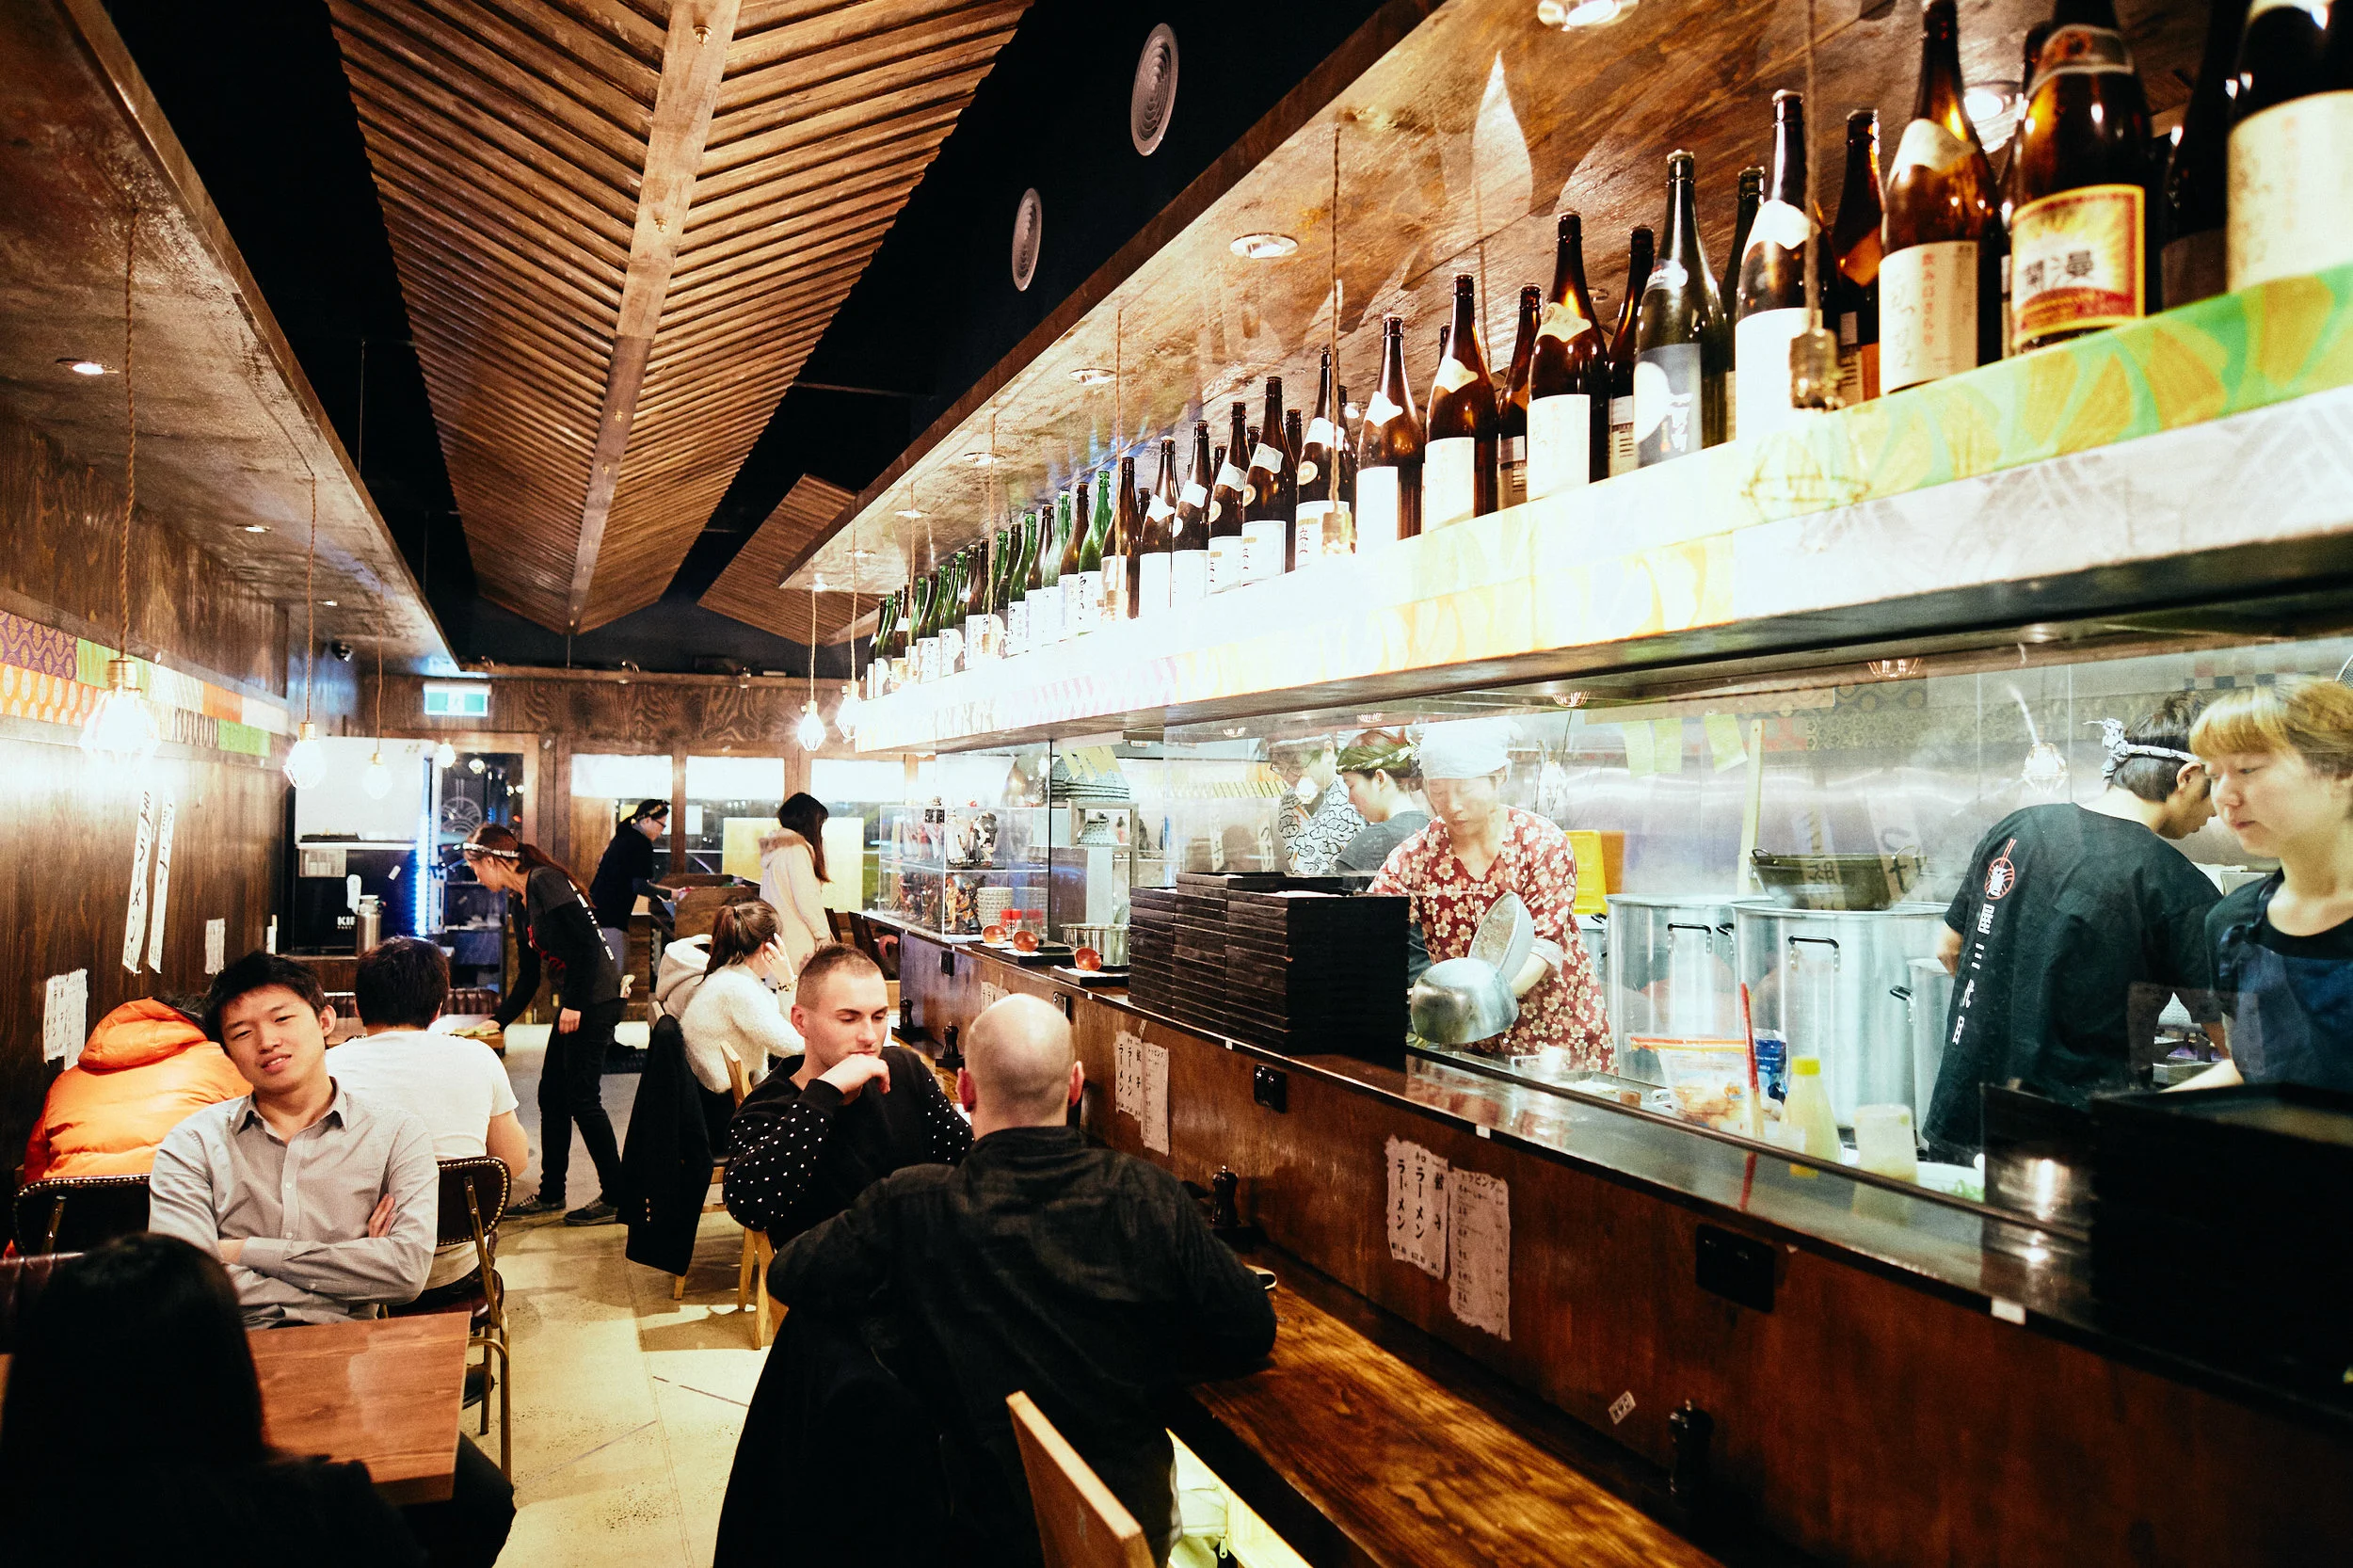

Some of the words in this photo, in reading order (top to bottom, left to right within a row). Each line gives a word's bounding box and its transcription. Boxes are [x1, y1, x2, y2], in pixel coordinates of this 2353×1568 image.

[1397, 1159, 1406, 1231] ラーメン
[1415, 1166, 1425, 1240] ラーメン
